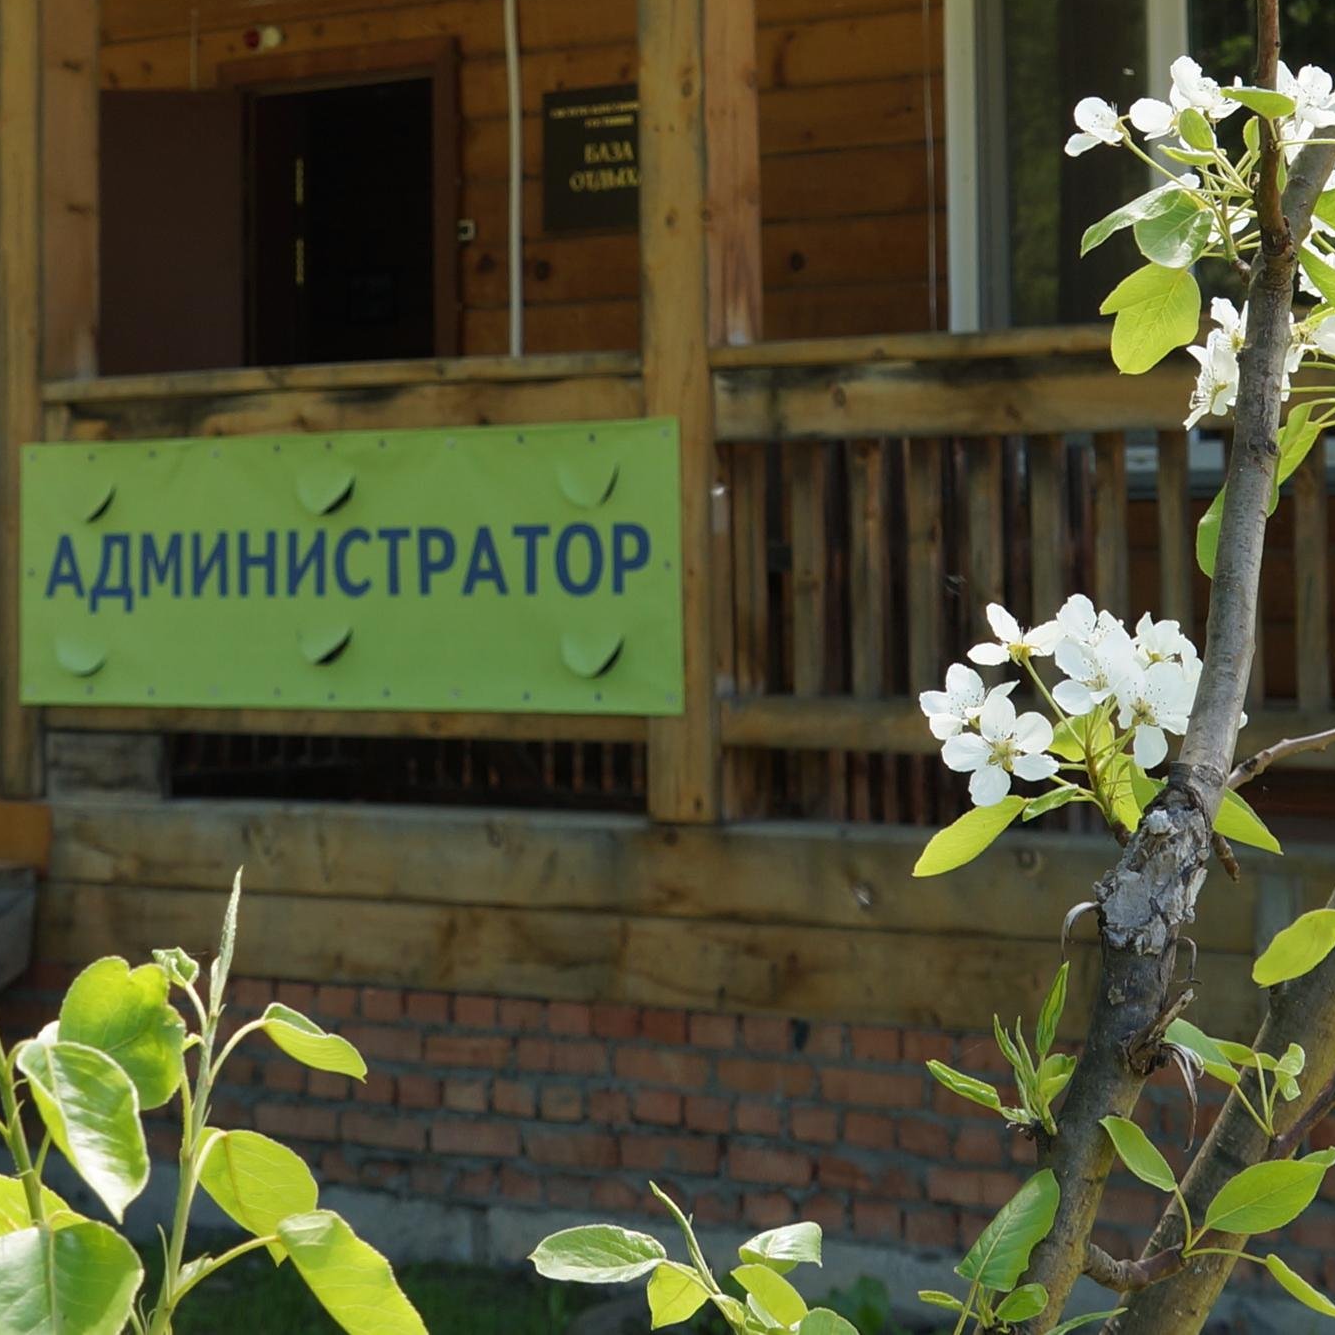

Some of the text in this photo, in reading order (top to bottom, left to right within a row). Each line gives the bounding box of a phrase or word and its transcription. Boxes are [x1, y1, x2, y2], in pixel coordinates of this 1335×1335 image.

[584, 140, 634, 164] БАЗА
[569, 167, 642, 192] ОТДЫХ
[44, 522, 652, 614] АДМИНИСТРАТОР
